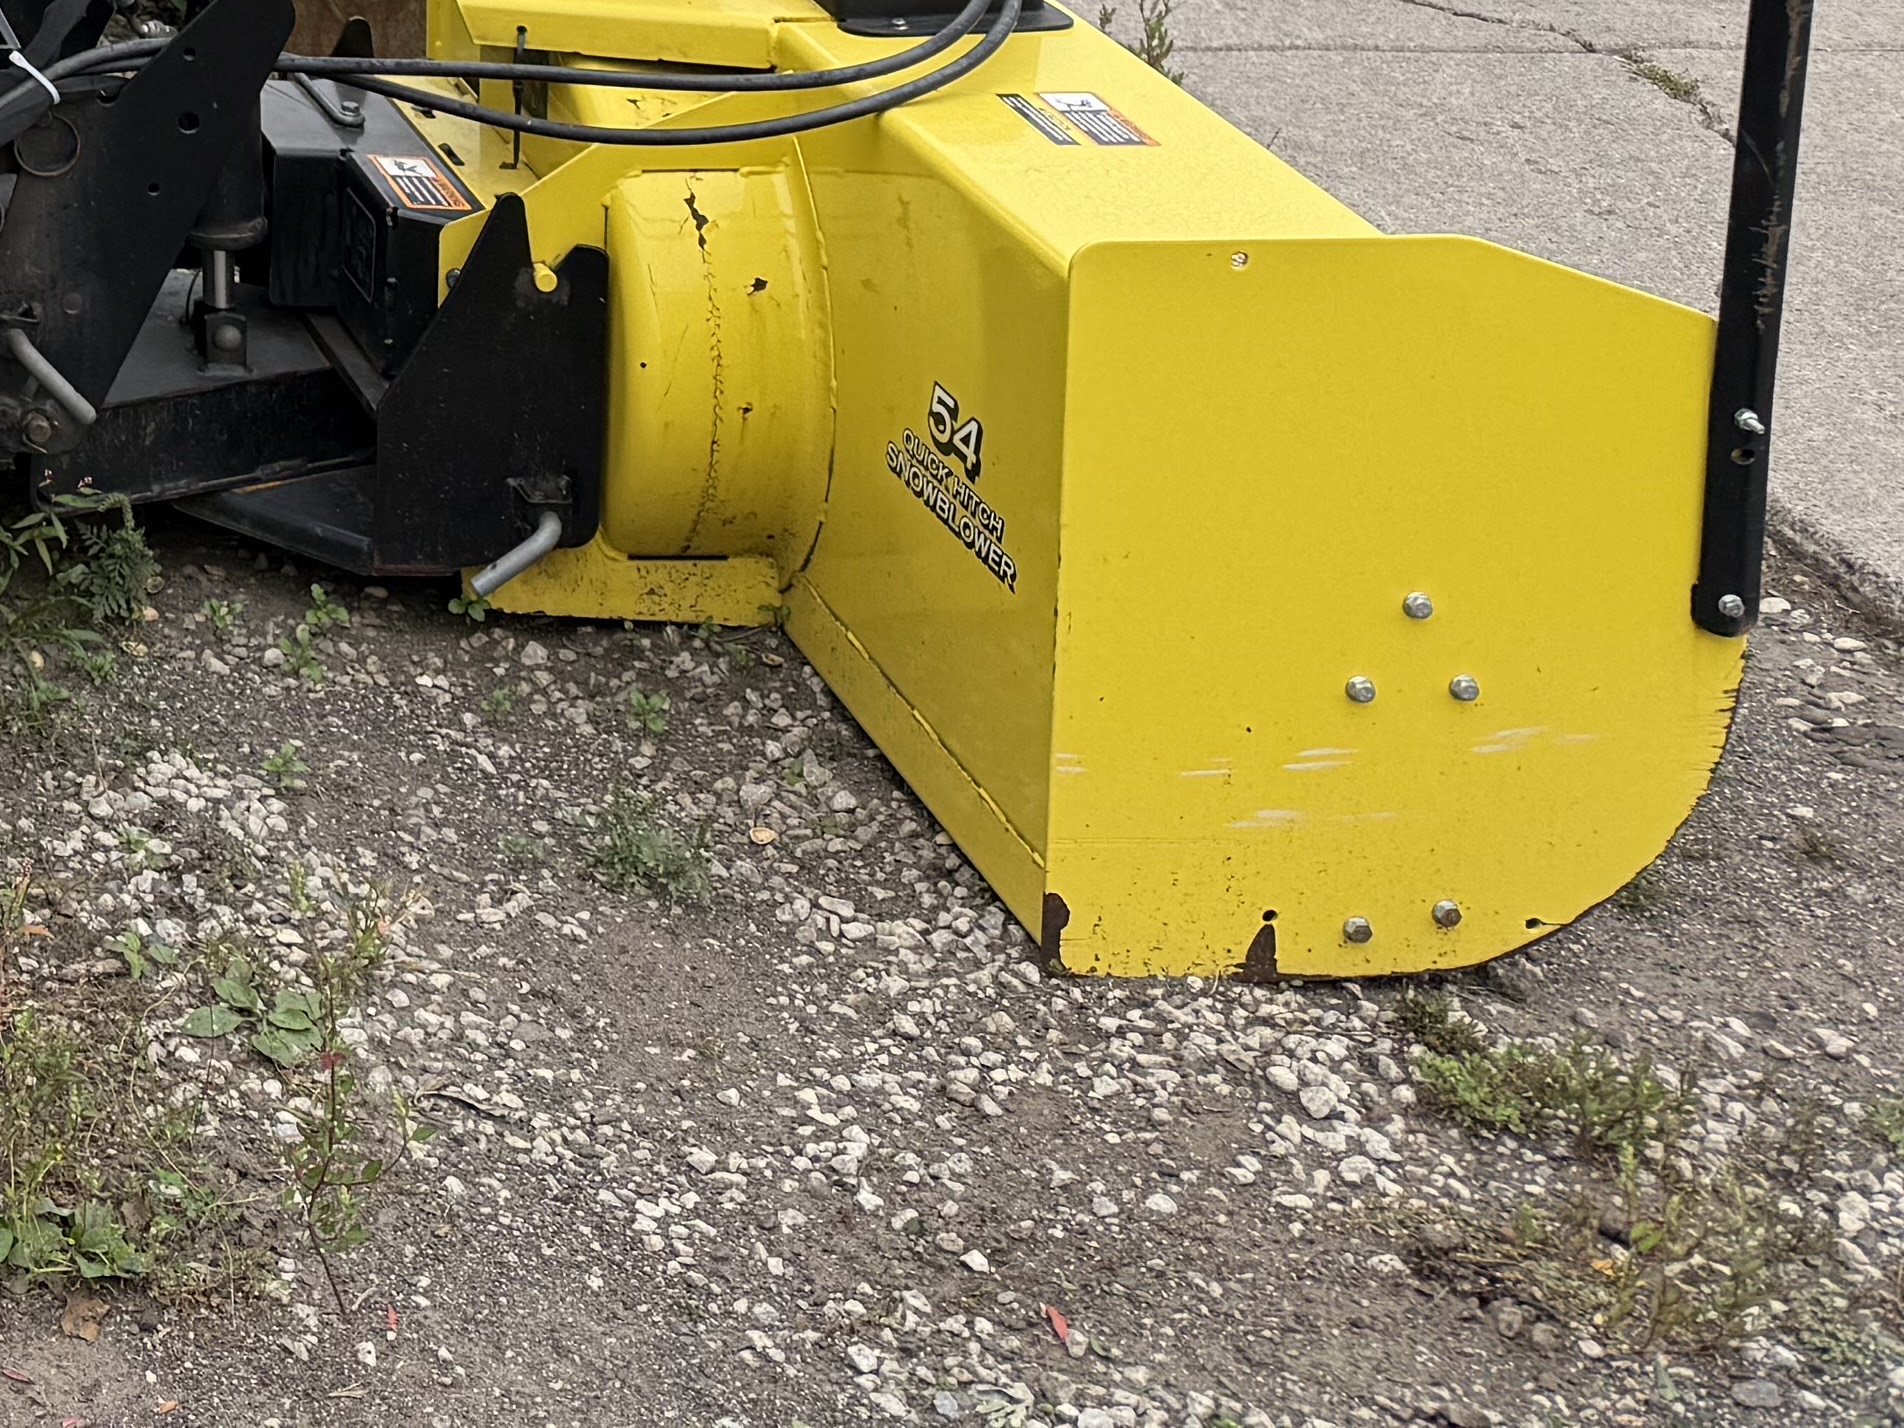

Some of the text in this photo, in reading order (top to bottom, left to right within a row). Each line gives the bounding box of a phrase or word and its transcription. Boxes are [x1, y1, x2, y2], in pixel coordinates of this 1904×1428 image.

[902, 428, 1005, 541] QUICK HITCH
[928, 382, 982, 482] 54
[886, 441, 1017, 590] SNOWBLOWER
